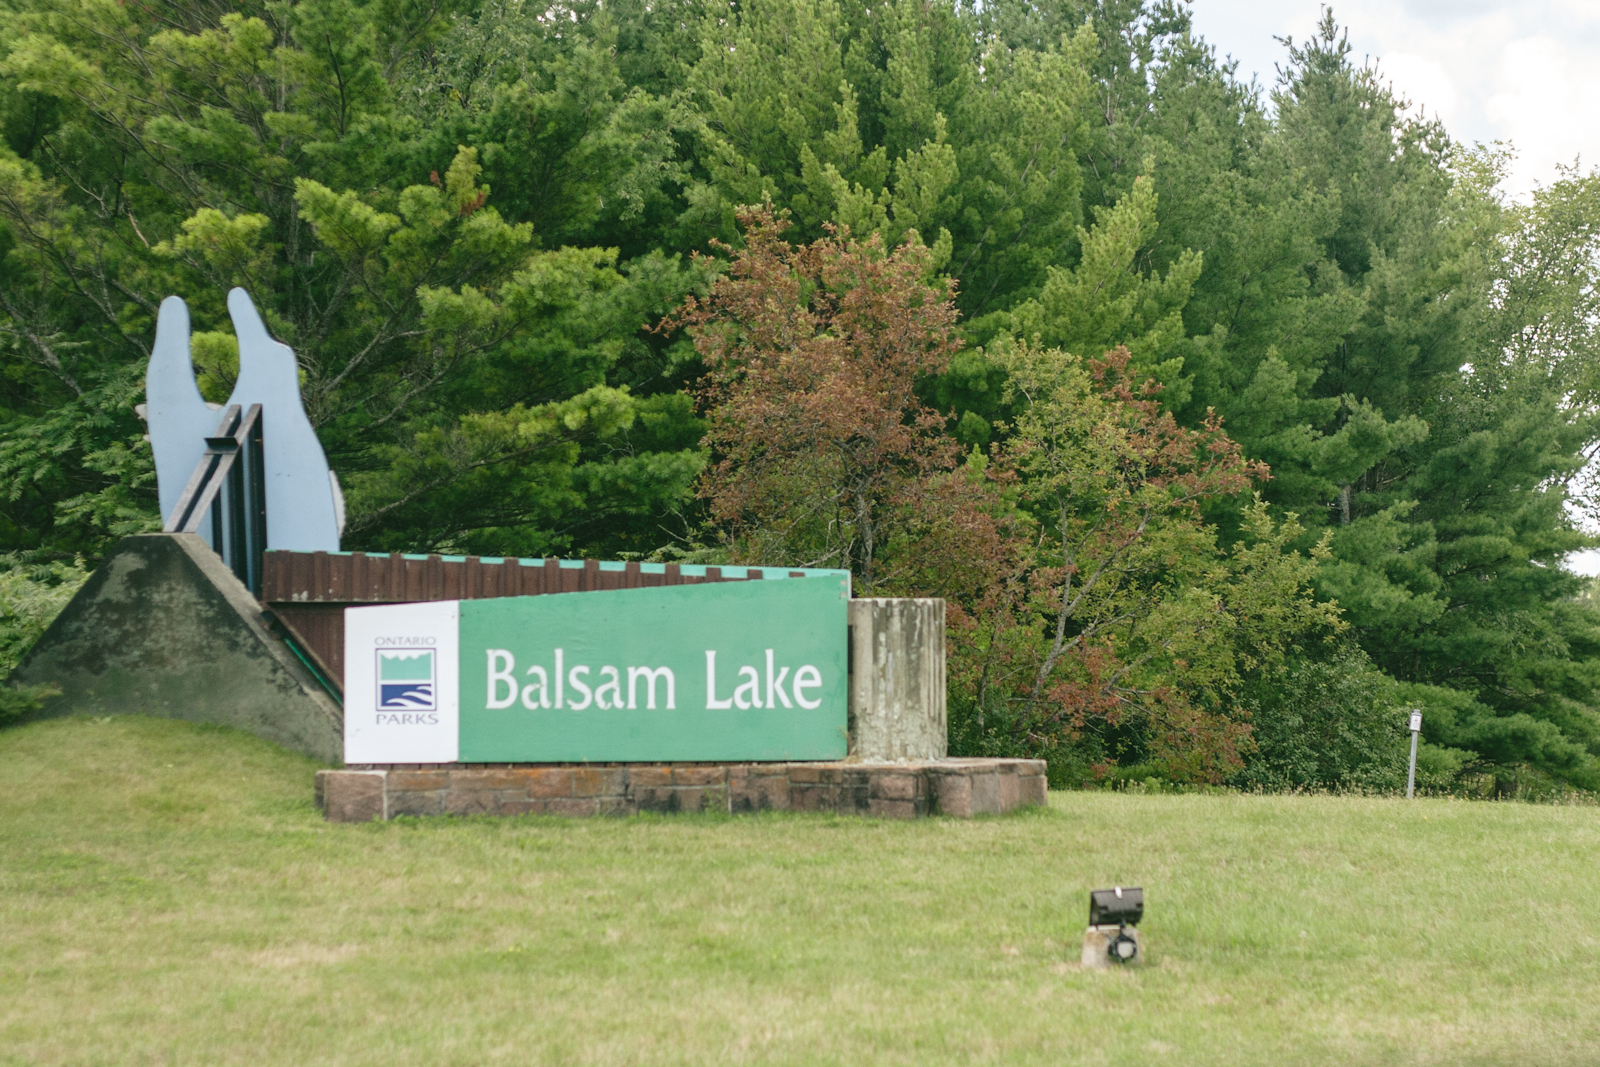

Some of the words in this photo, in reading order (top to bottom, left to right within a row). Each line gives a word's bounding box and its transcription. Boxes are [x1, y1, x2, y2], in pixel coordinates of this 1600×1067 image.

[374, 636, 436, 647] ONTARIO
[485, 647, 677, 711] Balsam
[705, 647, 823, 711] Lake
[376, 713, 439, 726] PARKS
